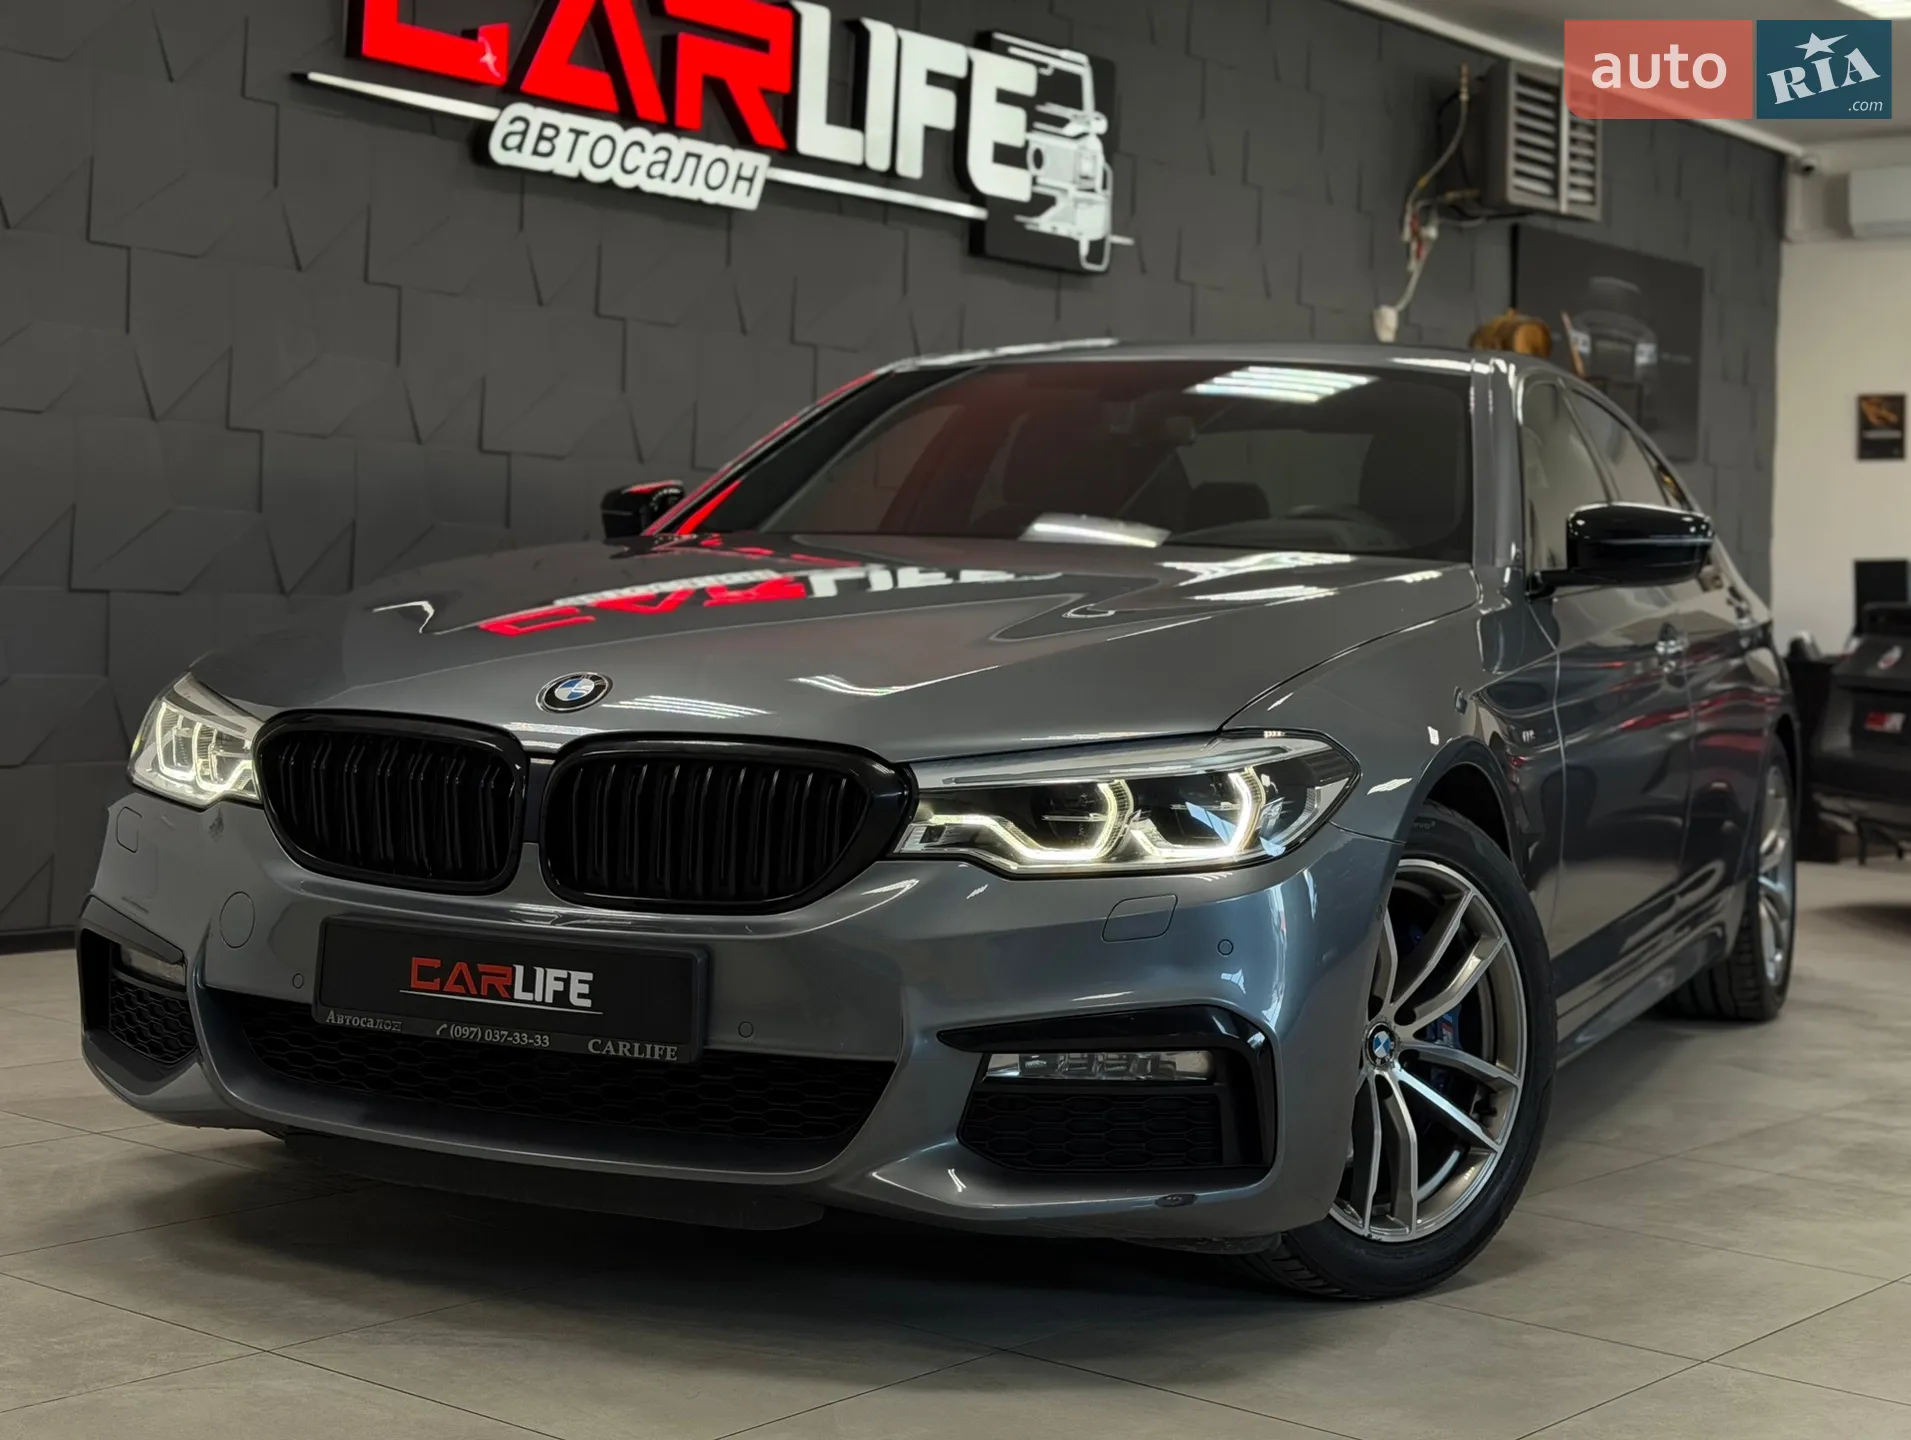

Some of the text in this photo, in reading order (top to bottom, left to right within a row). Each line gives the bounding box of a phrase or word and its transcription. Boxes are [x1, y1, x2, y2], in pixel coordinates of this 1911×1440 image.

[500, 114, 761, 198] автосалон
[410, 956, 594, 1008] CARLIFE
[449, 1023, 550, 1048] (097) 037-33-33
[587, 1038, 678, 1061] CARLIFE
